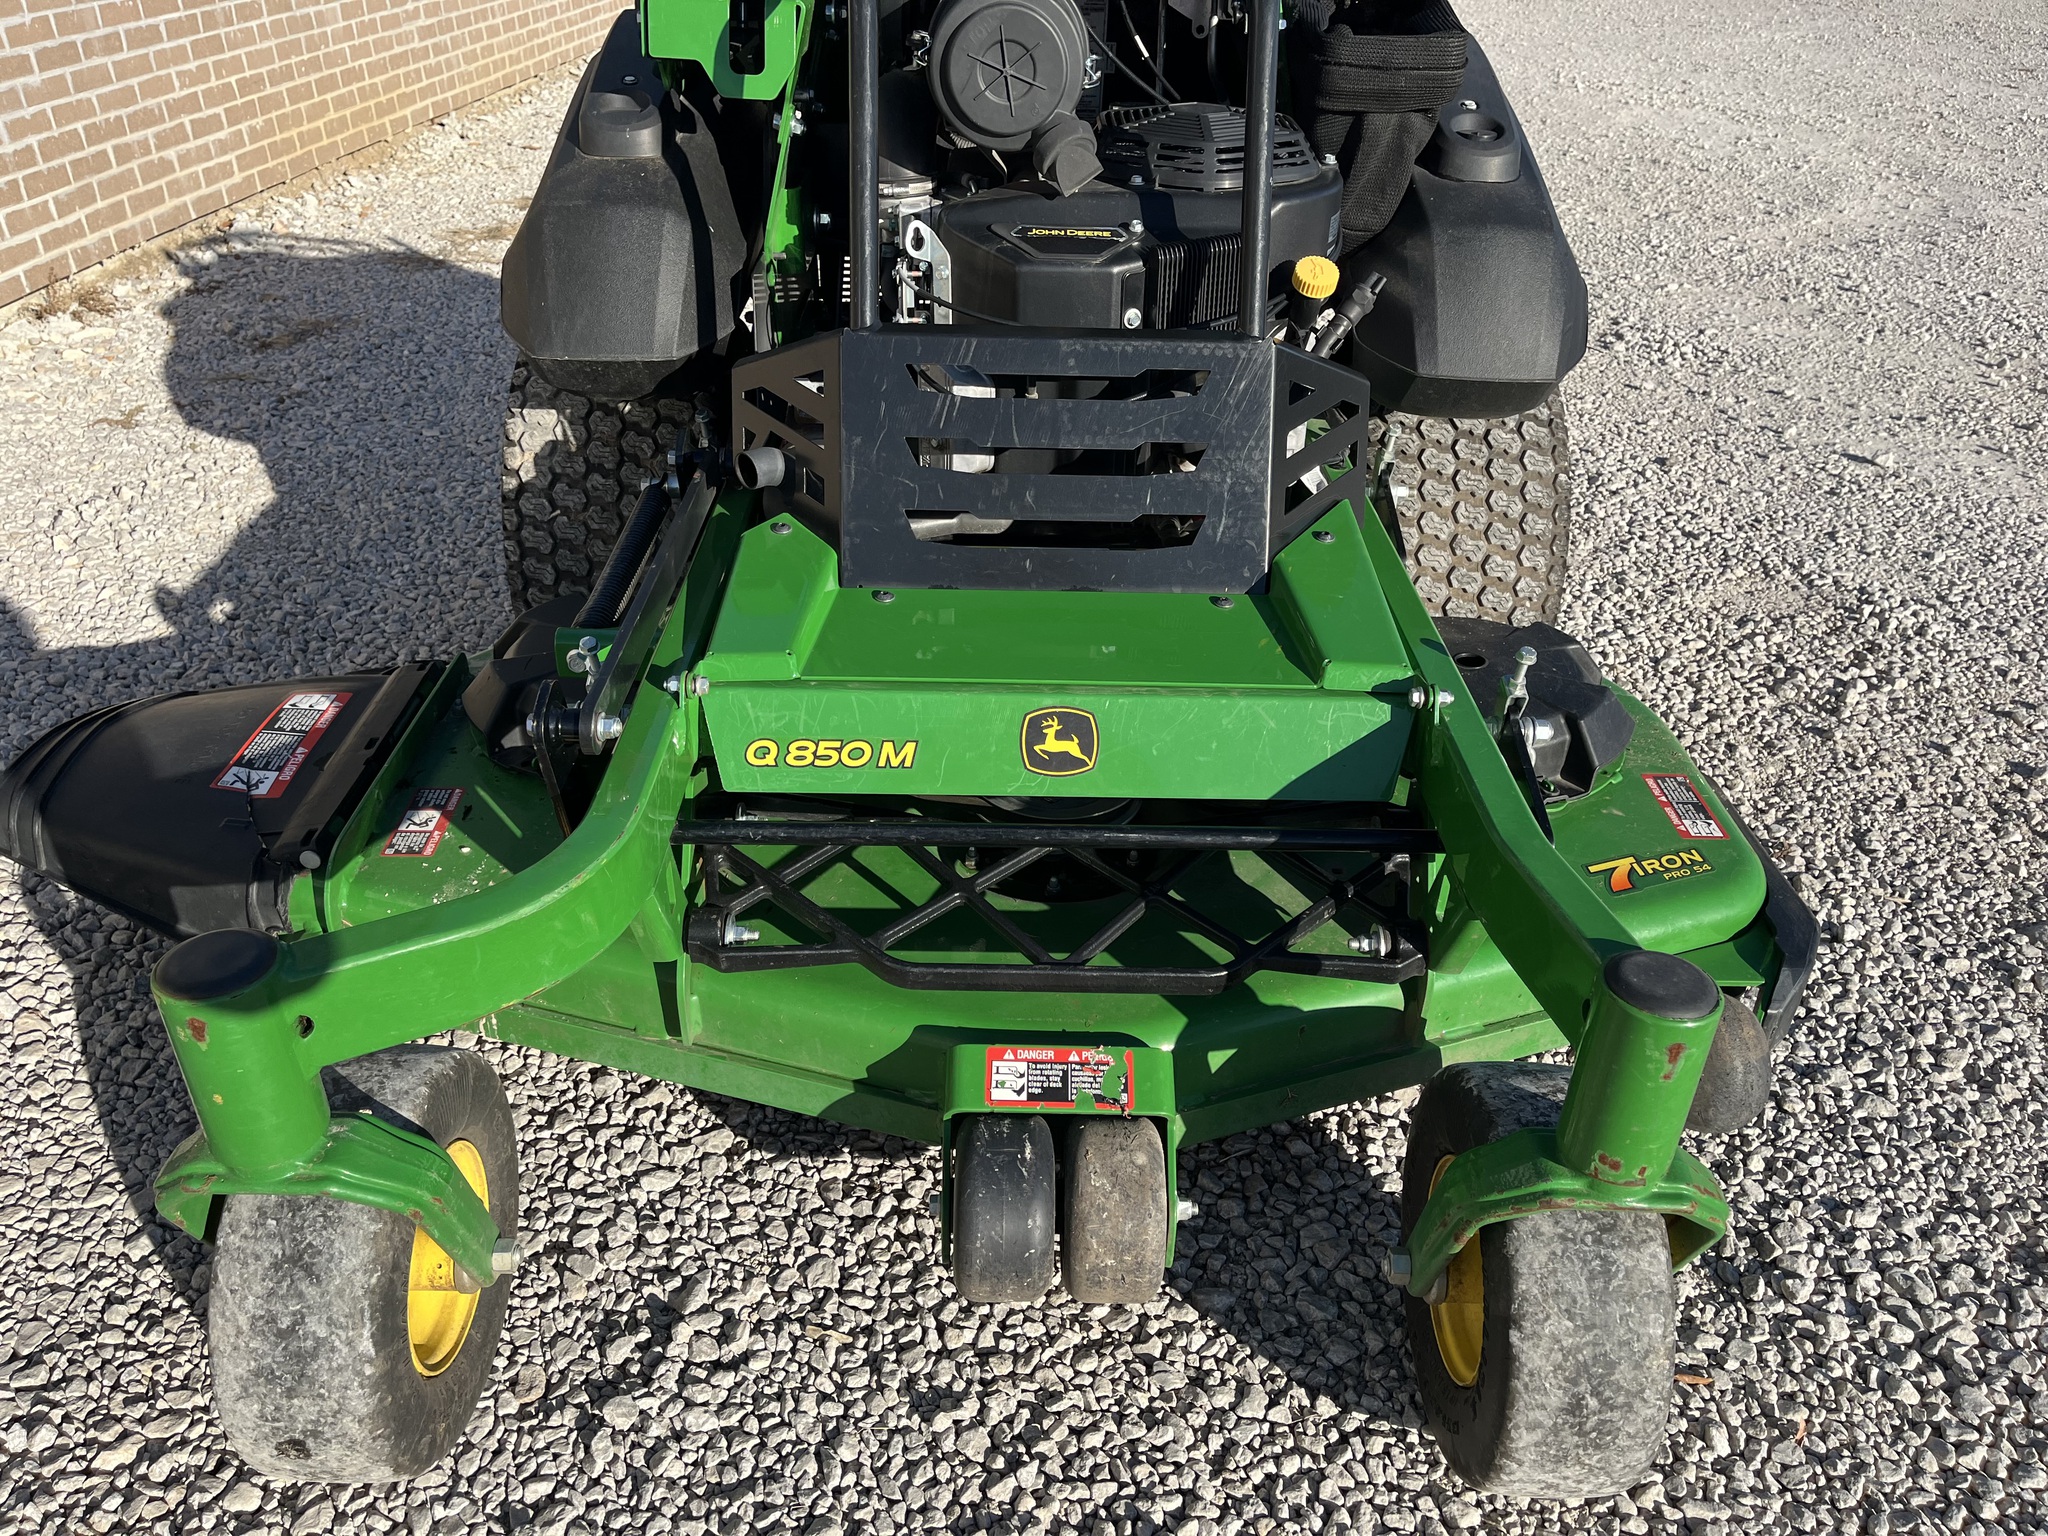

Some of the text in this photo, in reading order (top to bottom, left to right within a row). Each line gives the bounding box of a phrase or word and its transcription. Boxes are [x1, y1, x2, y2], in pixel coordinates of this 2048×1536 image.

[1027, 228, 1112, 237] JOHN DEERE
[745, 738, 919, 769] Q 850 M
[1663, 863, 1712, 881] PRO 54
[1017, 1050, 1055, 1060] DANGER
